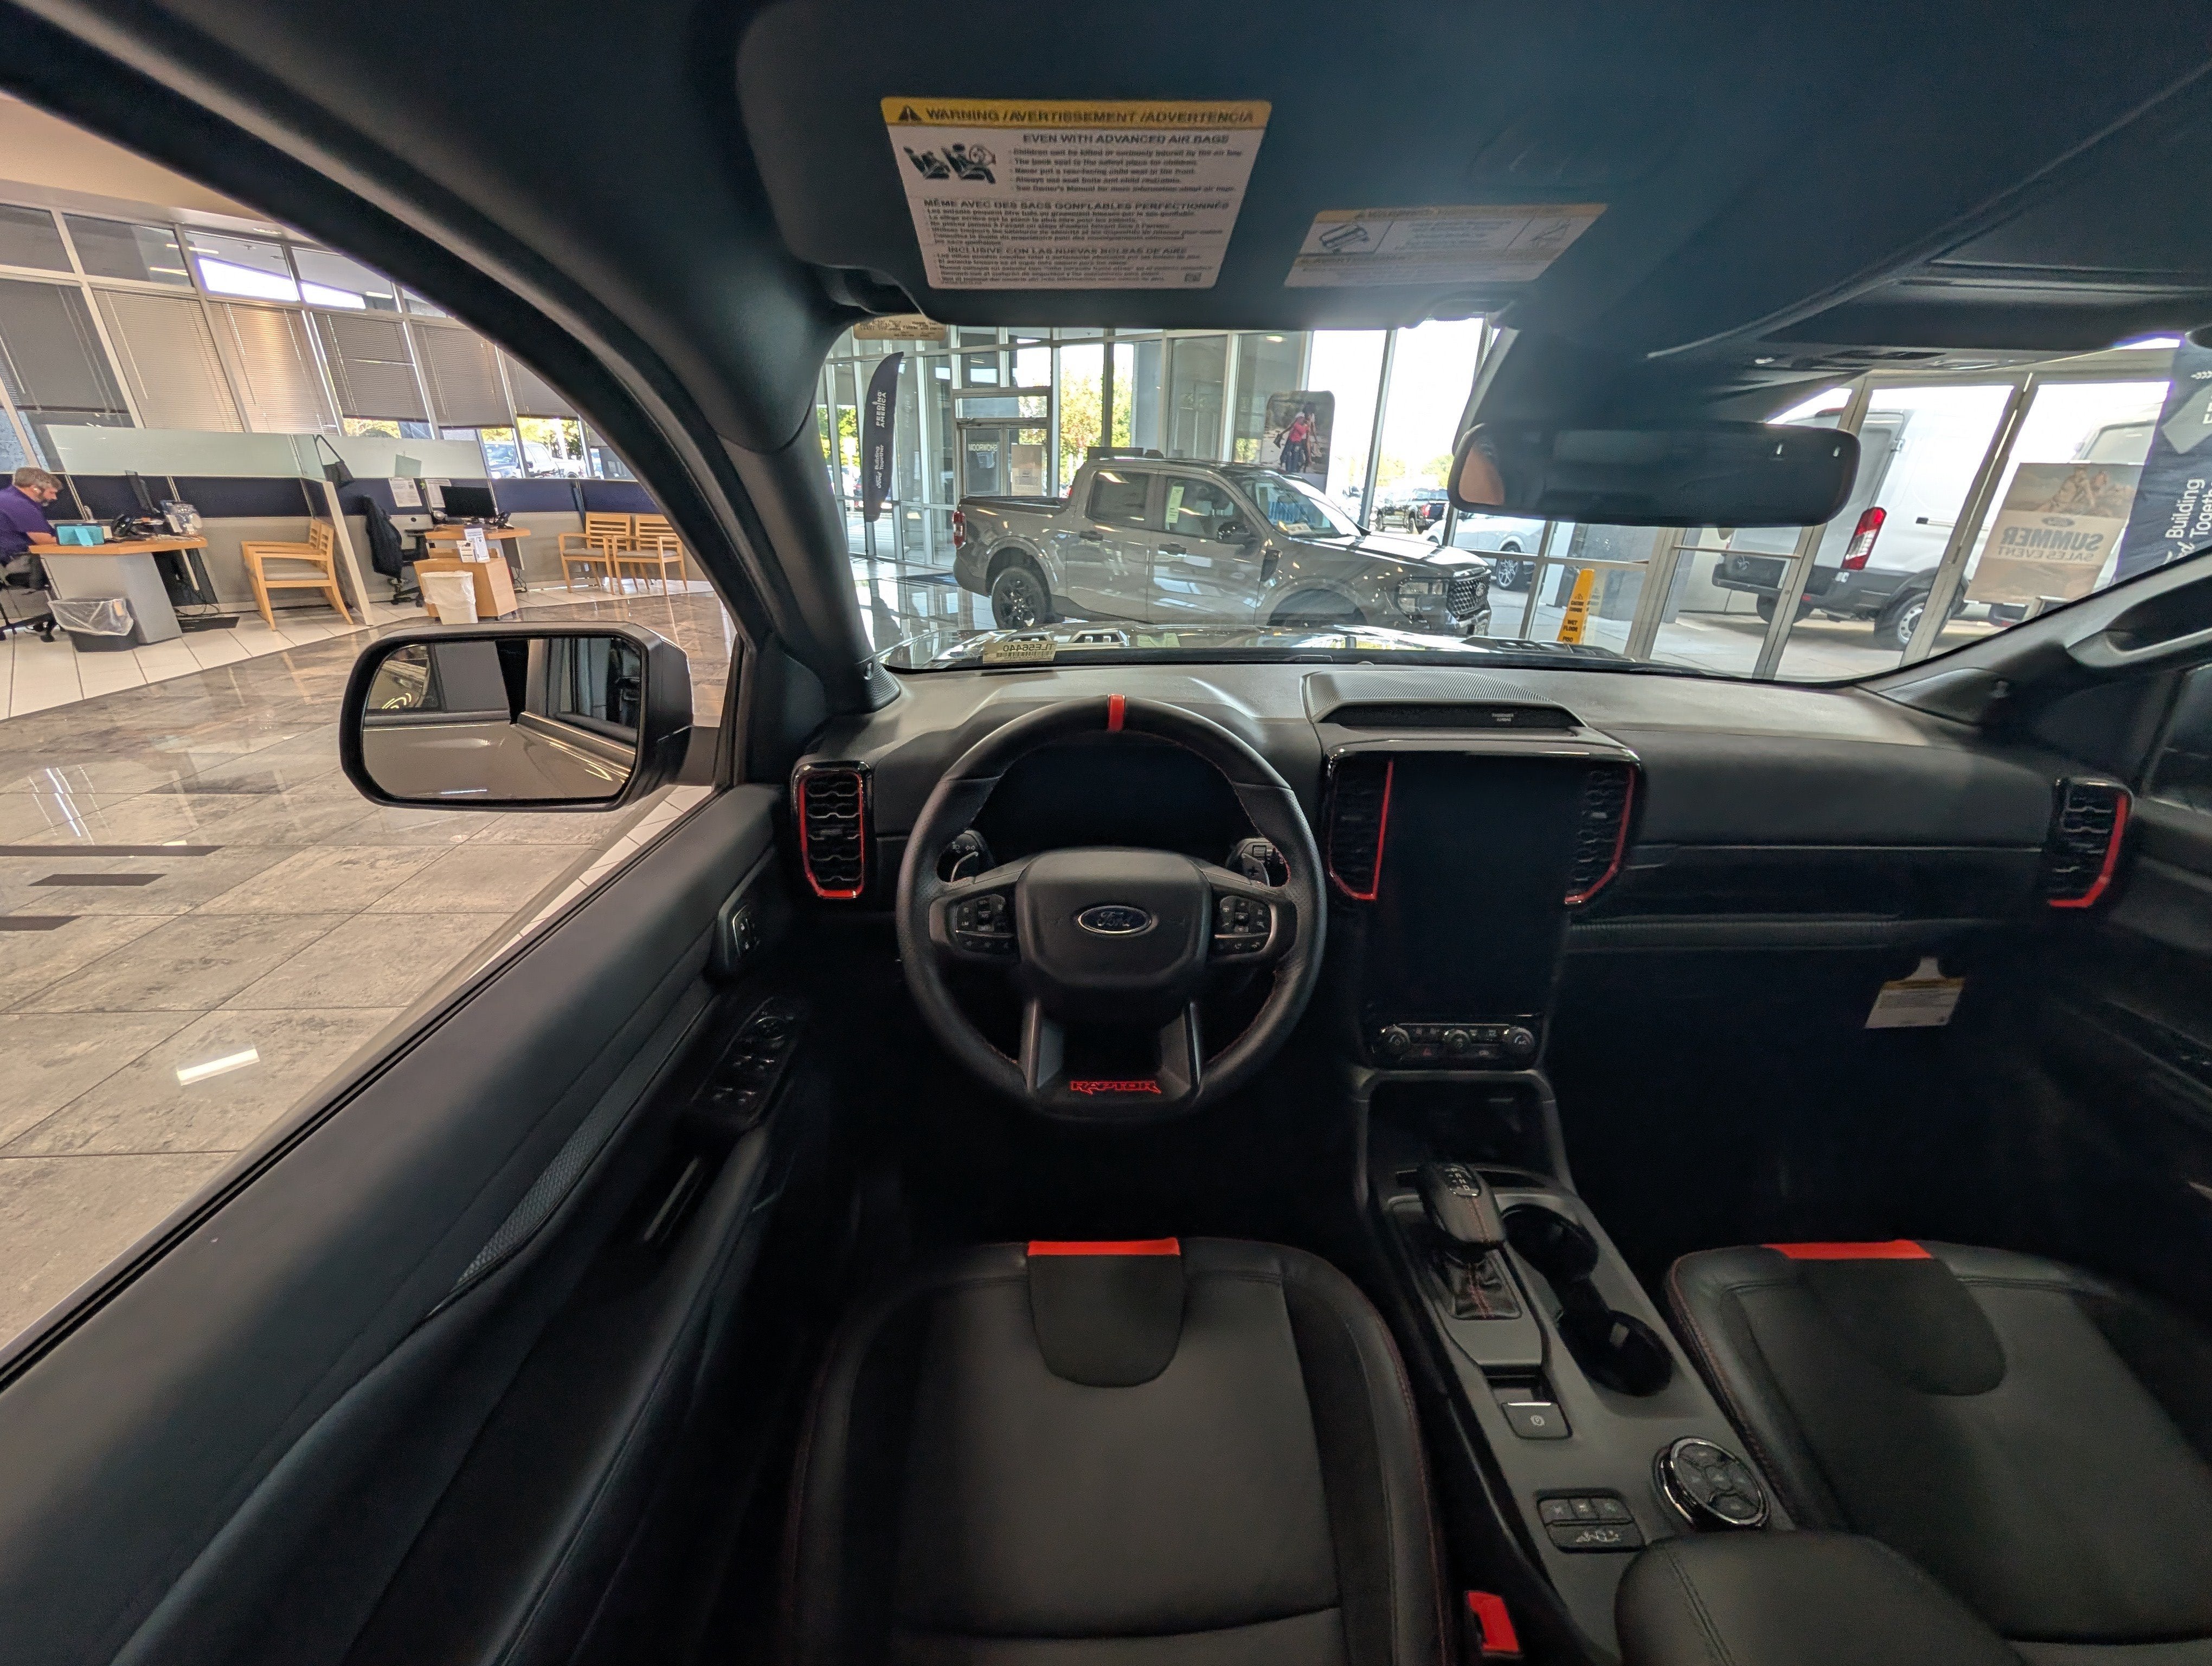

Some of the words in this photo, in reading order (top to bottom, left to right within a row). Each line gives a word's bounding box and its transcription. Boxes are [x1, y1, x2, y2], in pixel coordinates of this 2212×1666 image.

[925, 109, 998, 120] WARNING
[1023, 134, 1057, 142] EVEN
[1060, 134, 1093, 142] WITH
[1095, 134, 1165, 143] ADVANCED
[1168, 134, 1190, 143] AIR
[873, 391, 883, 427] FEEDING
[2165, 479, 2205, 538] Building
[2190, 481, 2212, 538] Togeth
[1097, 911, 1134, 926] Ford
[1070, 1081, 1161, 1094] RAPTOR
